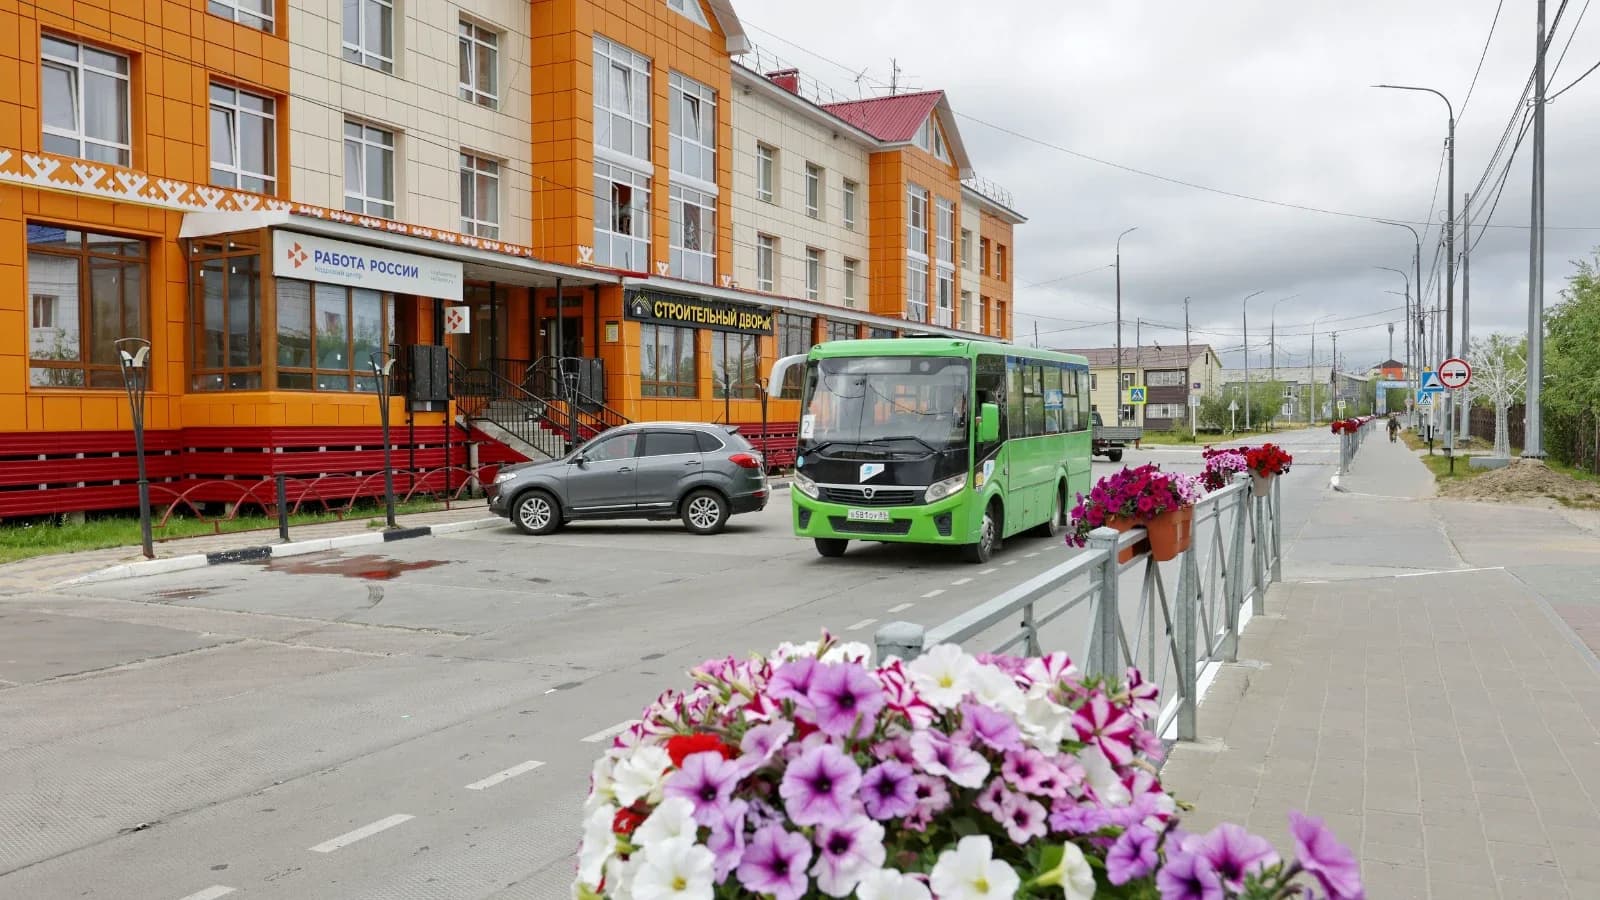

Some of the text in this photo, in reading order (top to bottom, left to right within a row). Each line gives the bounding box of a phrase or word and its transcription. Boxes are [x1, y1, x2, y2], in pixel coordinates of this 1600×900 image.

[314, 250, 365, 271] РАБОТА
[370, 259, 419, 279] РОССИИ
[654, 301, 738, 327] СТРОИТЕЛЬНЫЙ
[804, 420, 810, 433] 2
